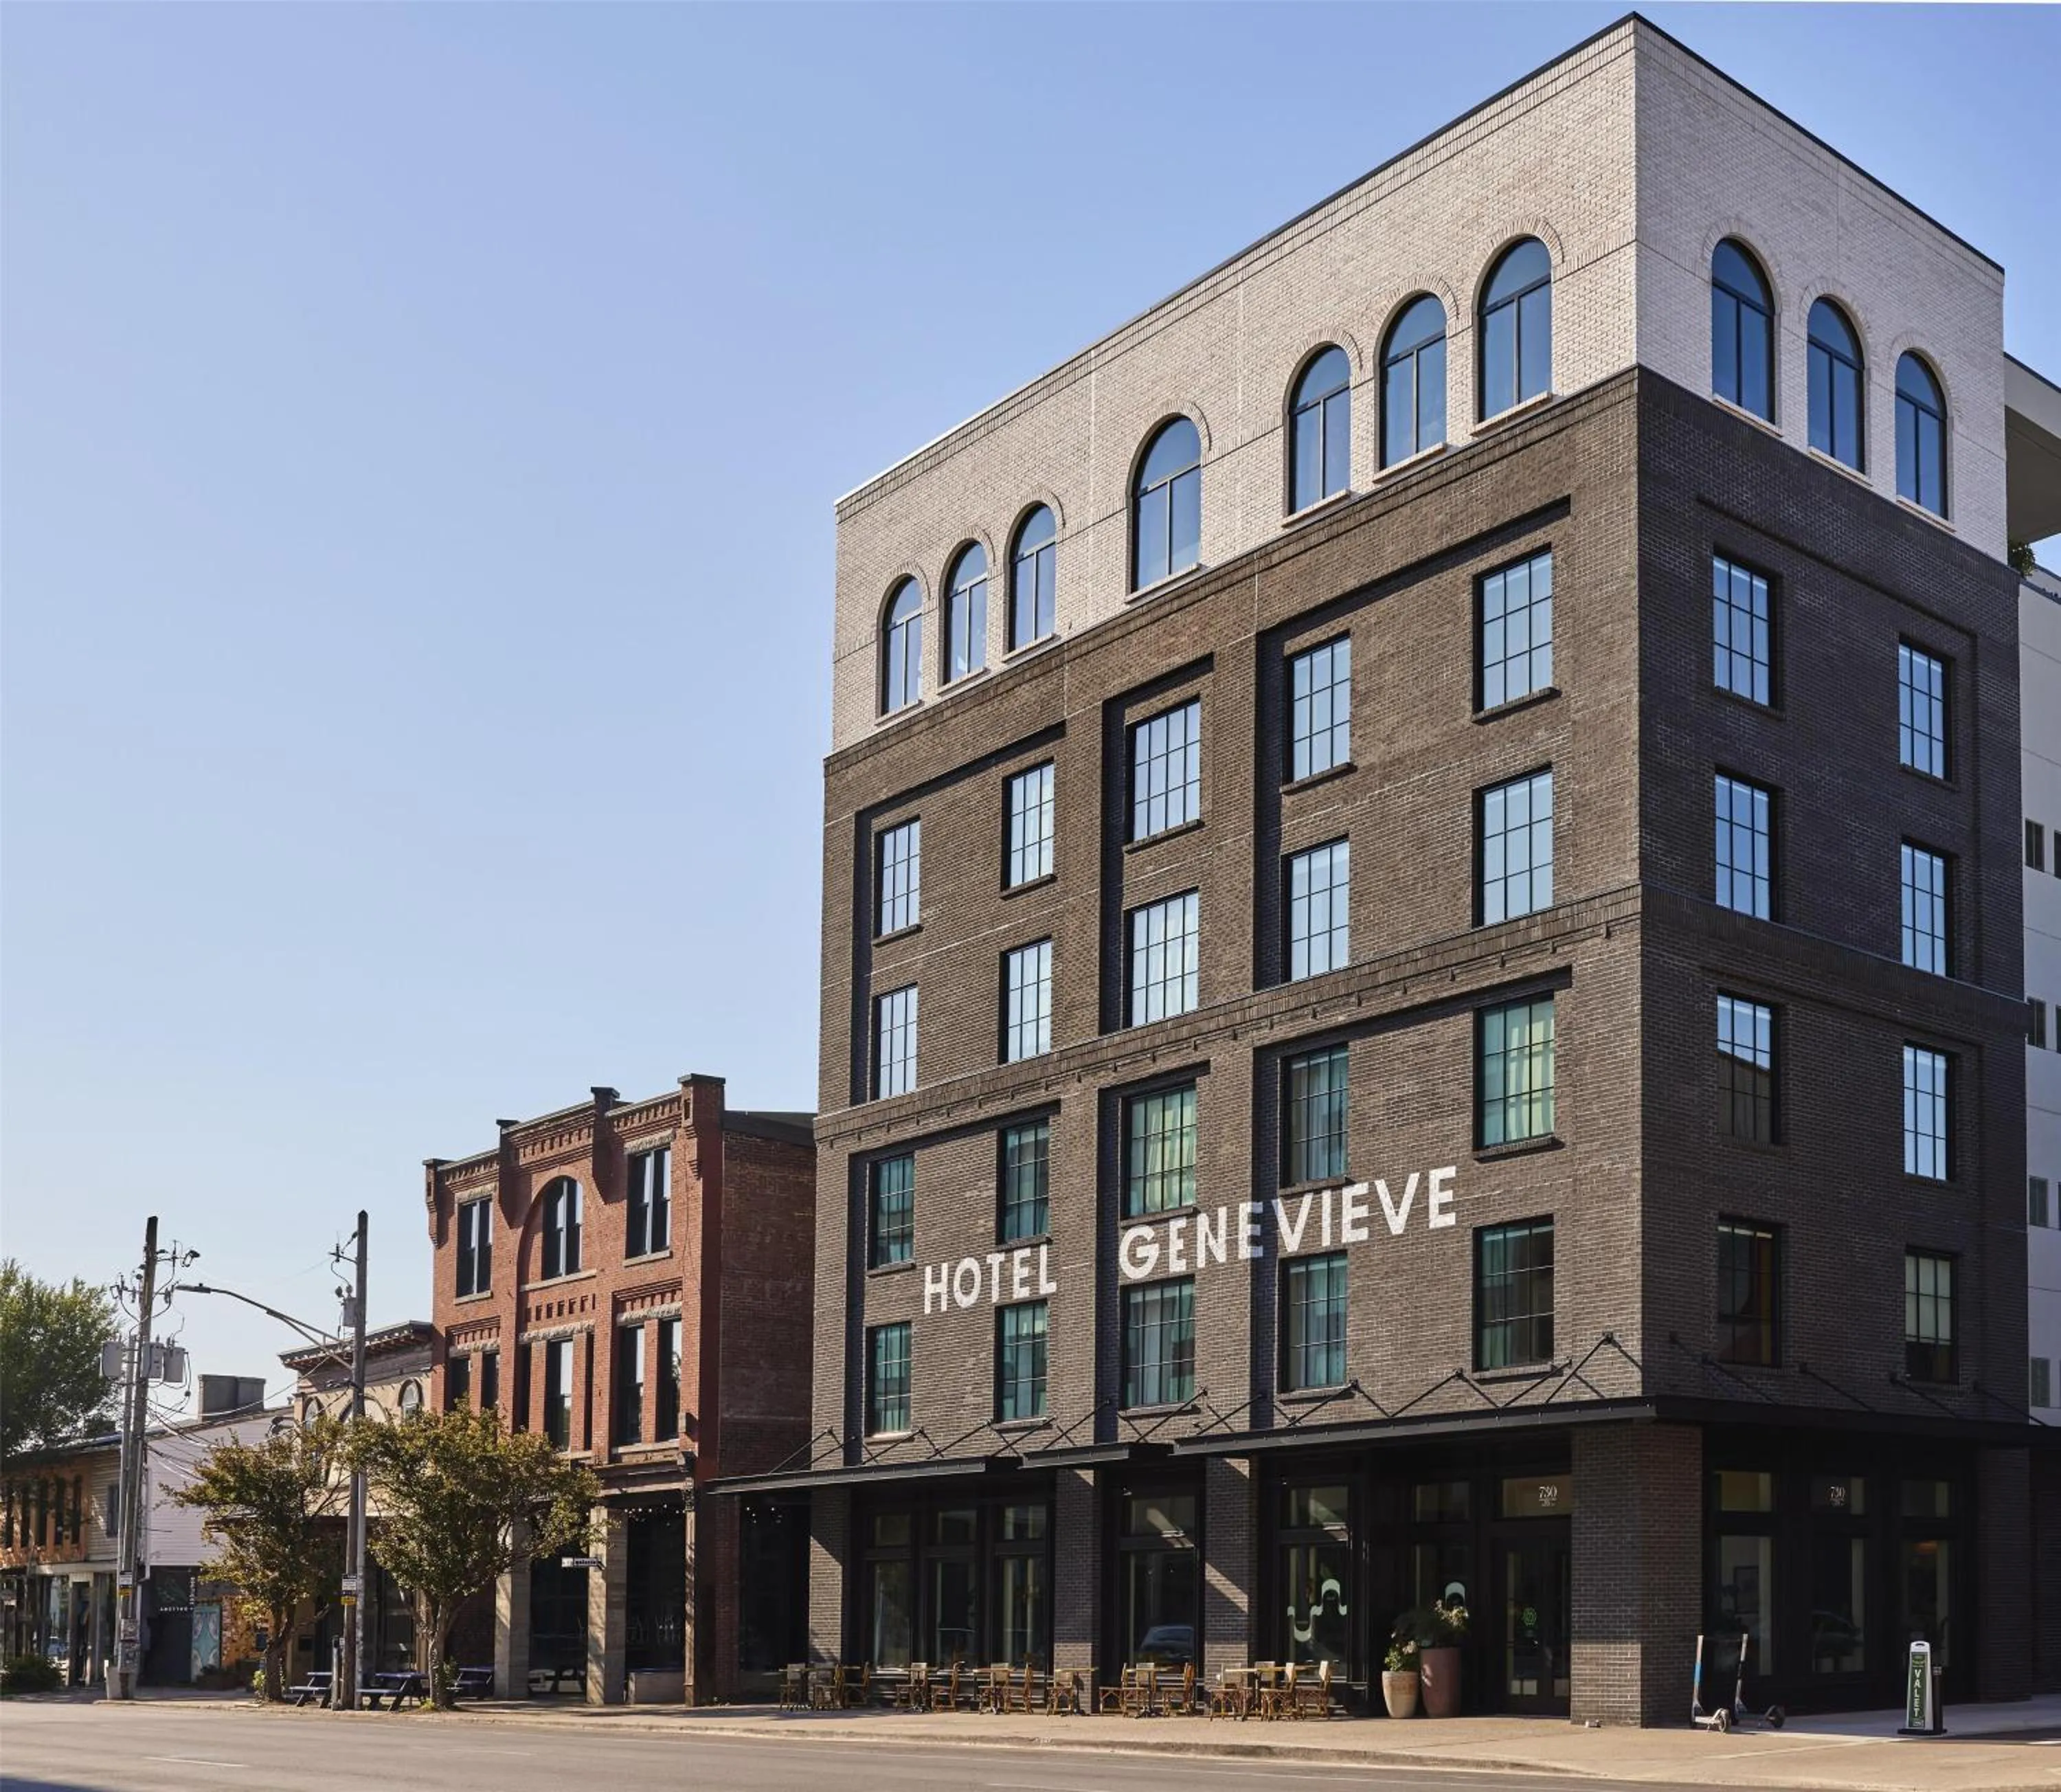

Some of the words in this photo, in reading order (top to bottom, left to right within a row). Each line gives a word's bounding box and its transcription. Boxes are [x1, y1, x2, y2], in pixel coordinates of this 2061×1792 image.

[923, 1243, 1057, 1314] HOTEL
[1118, 1166, 1458, 1280] GENEVIEVE
[1913, 1669, 1922, 1717] VALET
